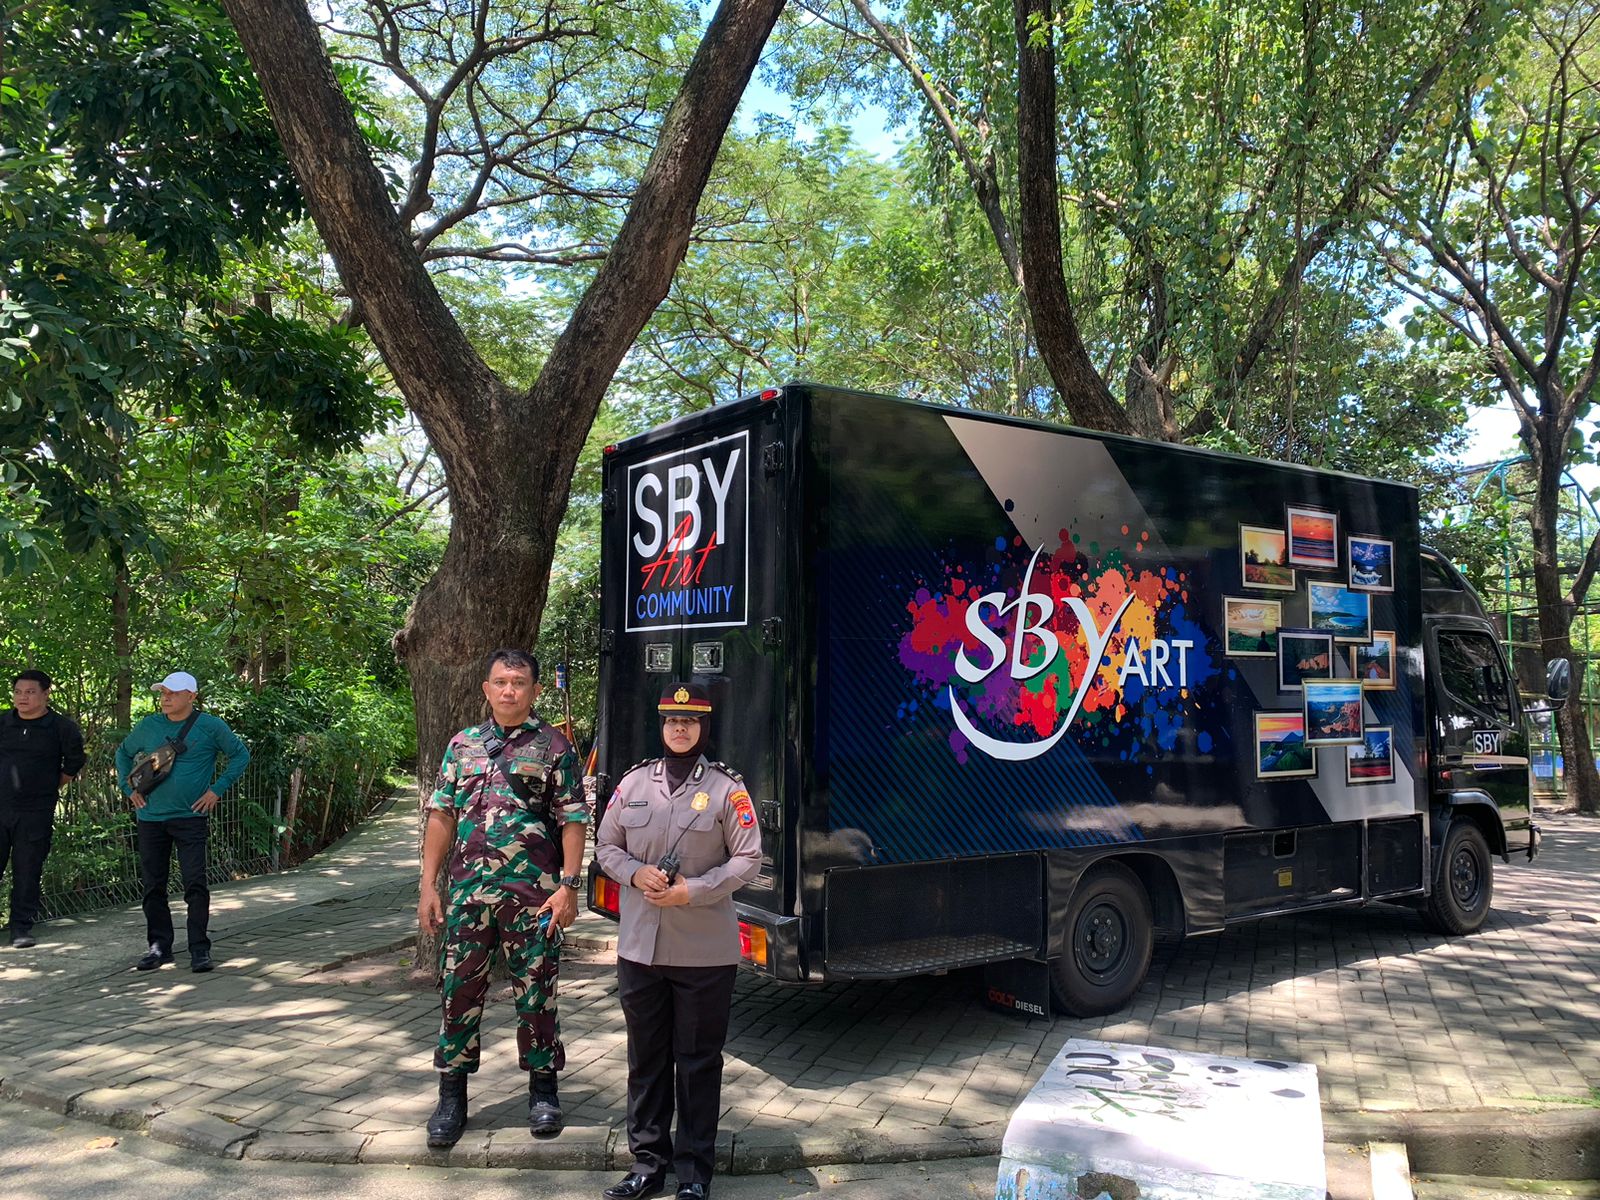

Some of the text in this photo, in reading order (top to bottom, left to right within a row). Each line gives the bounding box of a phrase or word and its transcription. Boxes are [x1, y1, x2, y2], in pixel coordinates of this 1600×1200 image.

[633, 448, 741, 558] SBY
[641, 514, 718, 590] Art
[636, 585, 733, 619] COMMUNITY
[949, 542, 1194, 761] SBY ART
[1475, 733, 1499, 754] SBY
[1015, 1000, 1045, 1016] DIESEL
